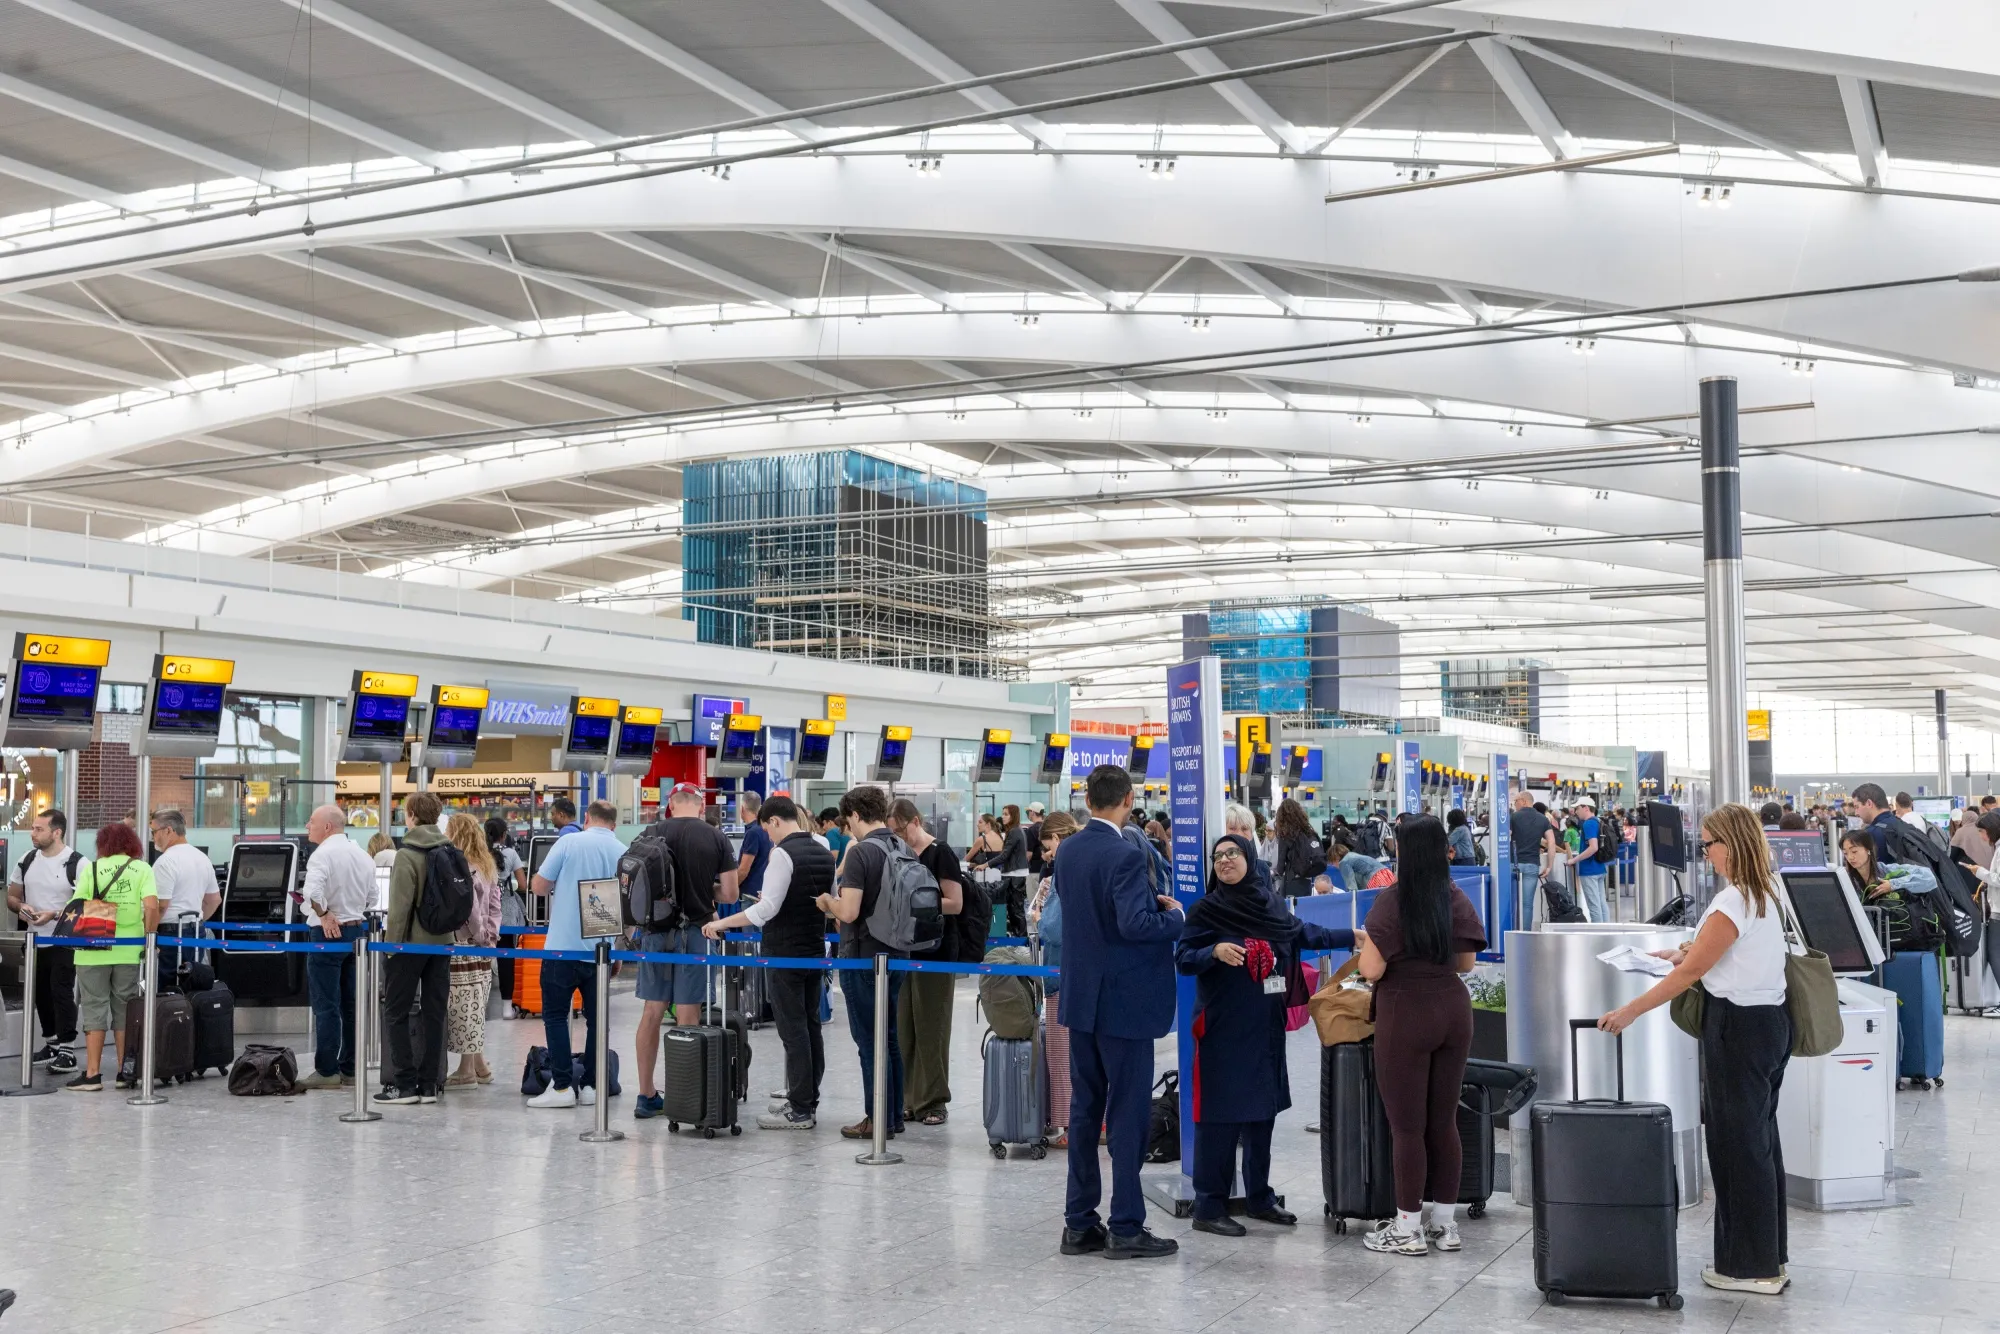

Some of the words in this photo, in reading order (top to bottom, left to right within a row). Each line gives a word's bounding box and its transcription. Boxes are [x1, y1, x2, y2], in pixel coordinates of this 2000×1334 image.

[45, 644, 59, 655] C2
[180, 664, 192, 674] C3
[374, 679, 384, 688] C4
[588, 702, 595, 710] C6
[1170, 696, 1191, 710] BRITISH
[1170, 710, 1192, 723] AIRWAYS
[1172, 746, 1192, 757] PASSPORT
[1192, 745, 1202, 755] AND
[1081, 750, 1091, 767] to
[1094, 753, 1110, 767] our
[1174, 761, 1184, 770] VISA
[1184, 760, 1198, 770] CHECK
[438, 778, 500, 788] BESTSELLING
[502, 777, 536, 787] BOOKS
[14, 798, 31, 826] FOOD
